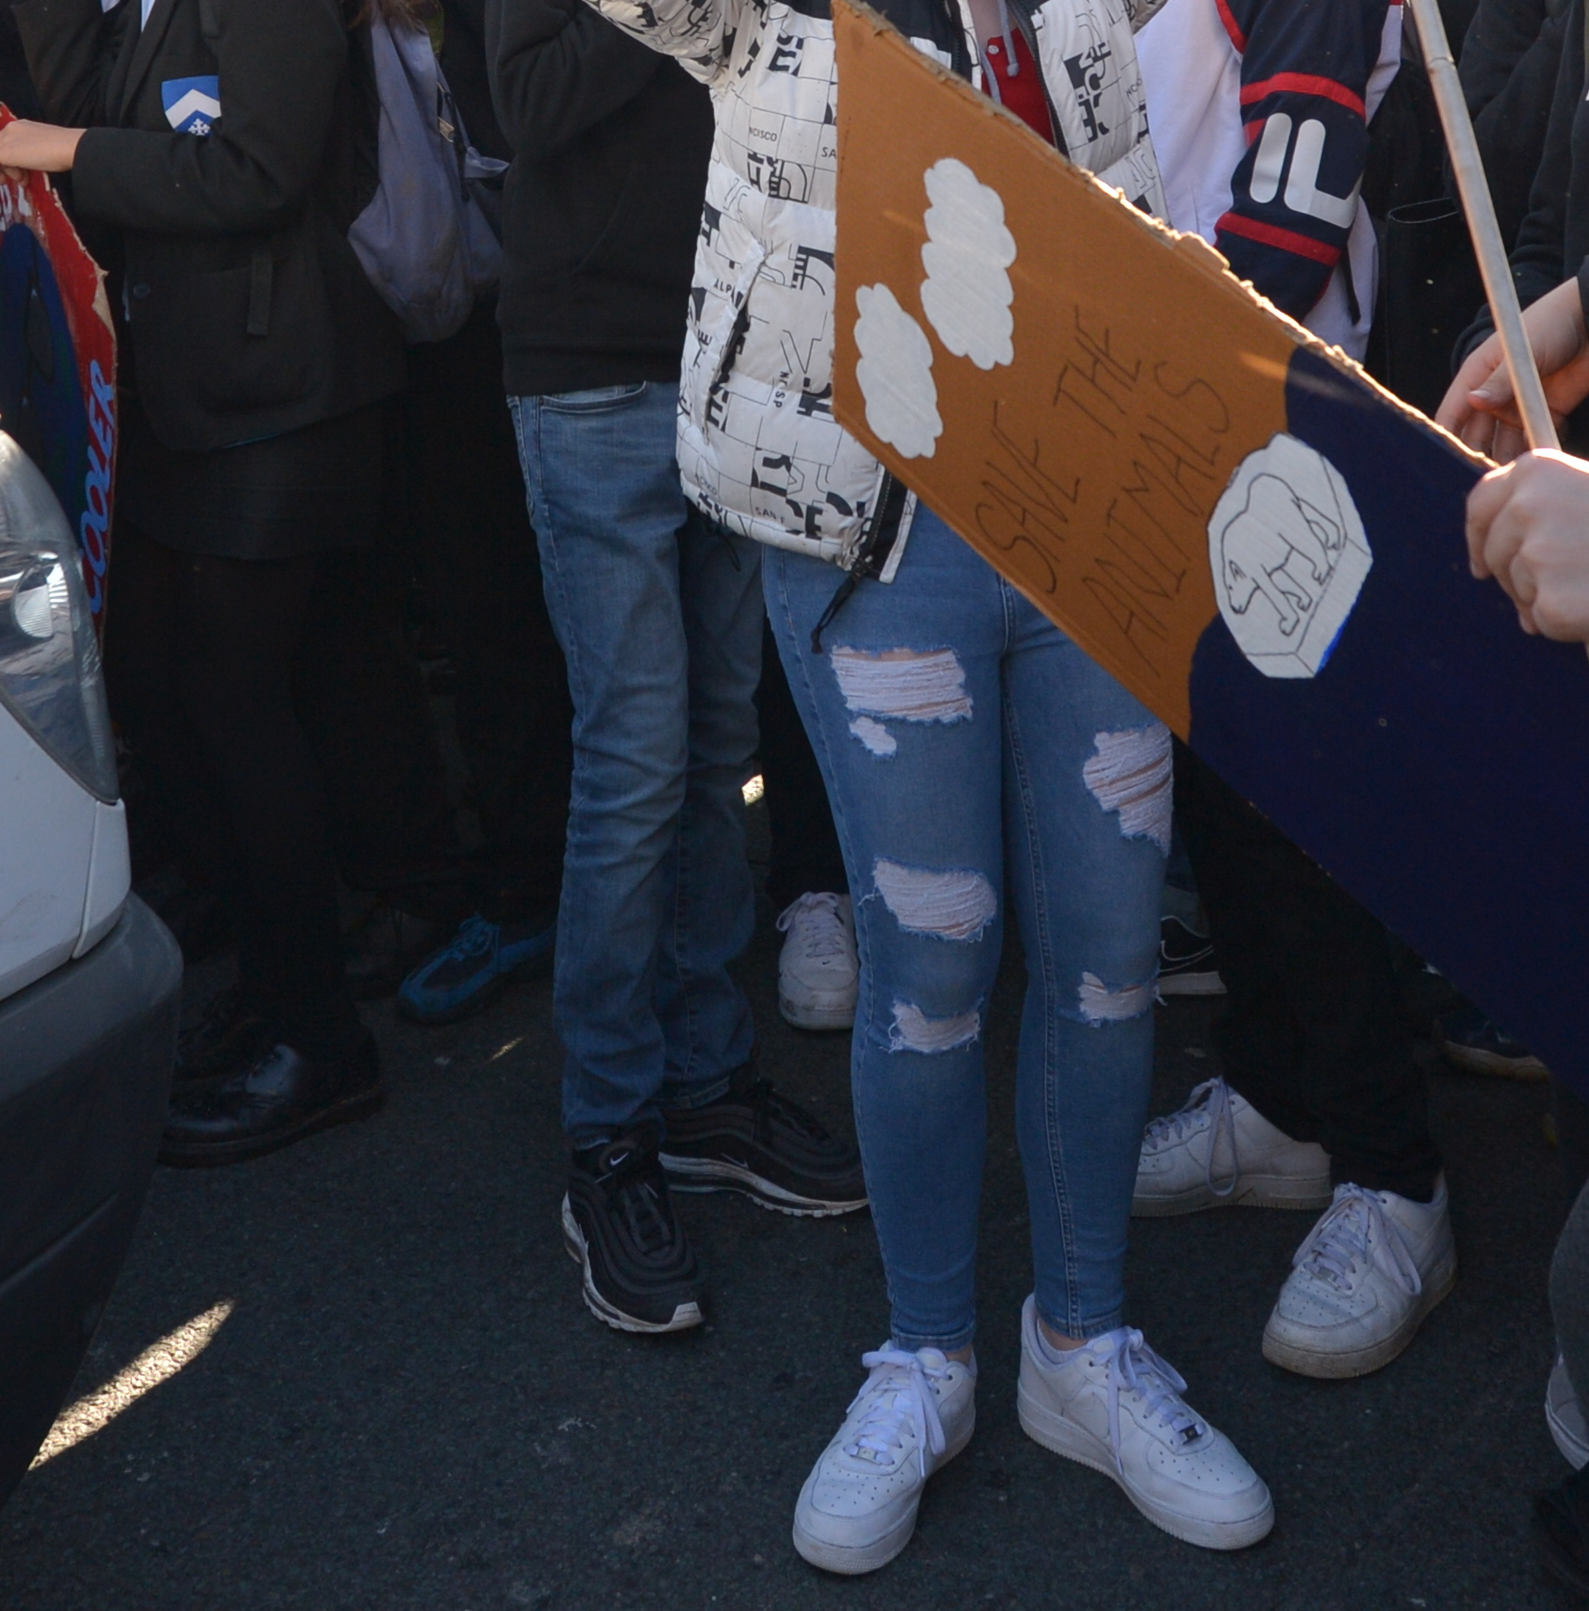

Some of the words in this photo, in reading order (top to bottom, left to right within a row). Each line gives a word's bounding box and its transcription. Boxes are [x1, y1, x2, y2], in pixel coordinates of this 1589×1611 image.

[974, 399, 1081, 594] SAVE
[1052, 303, 1143, 439] THE
[1081, 359, 1231, 679] ANIMALS
